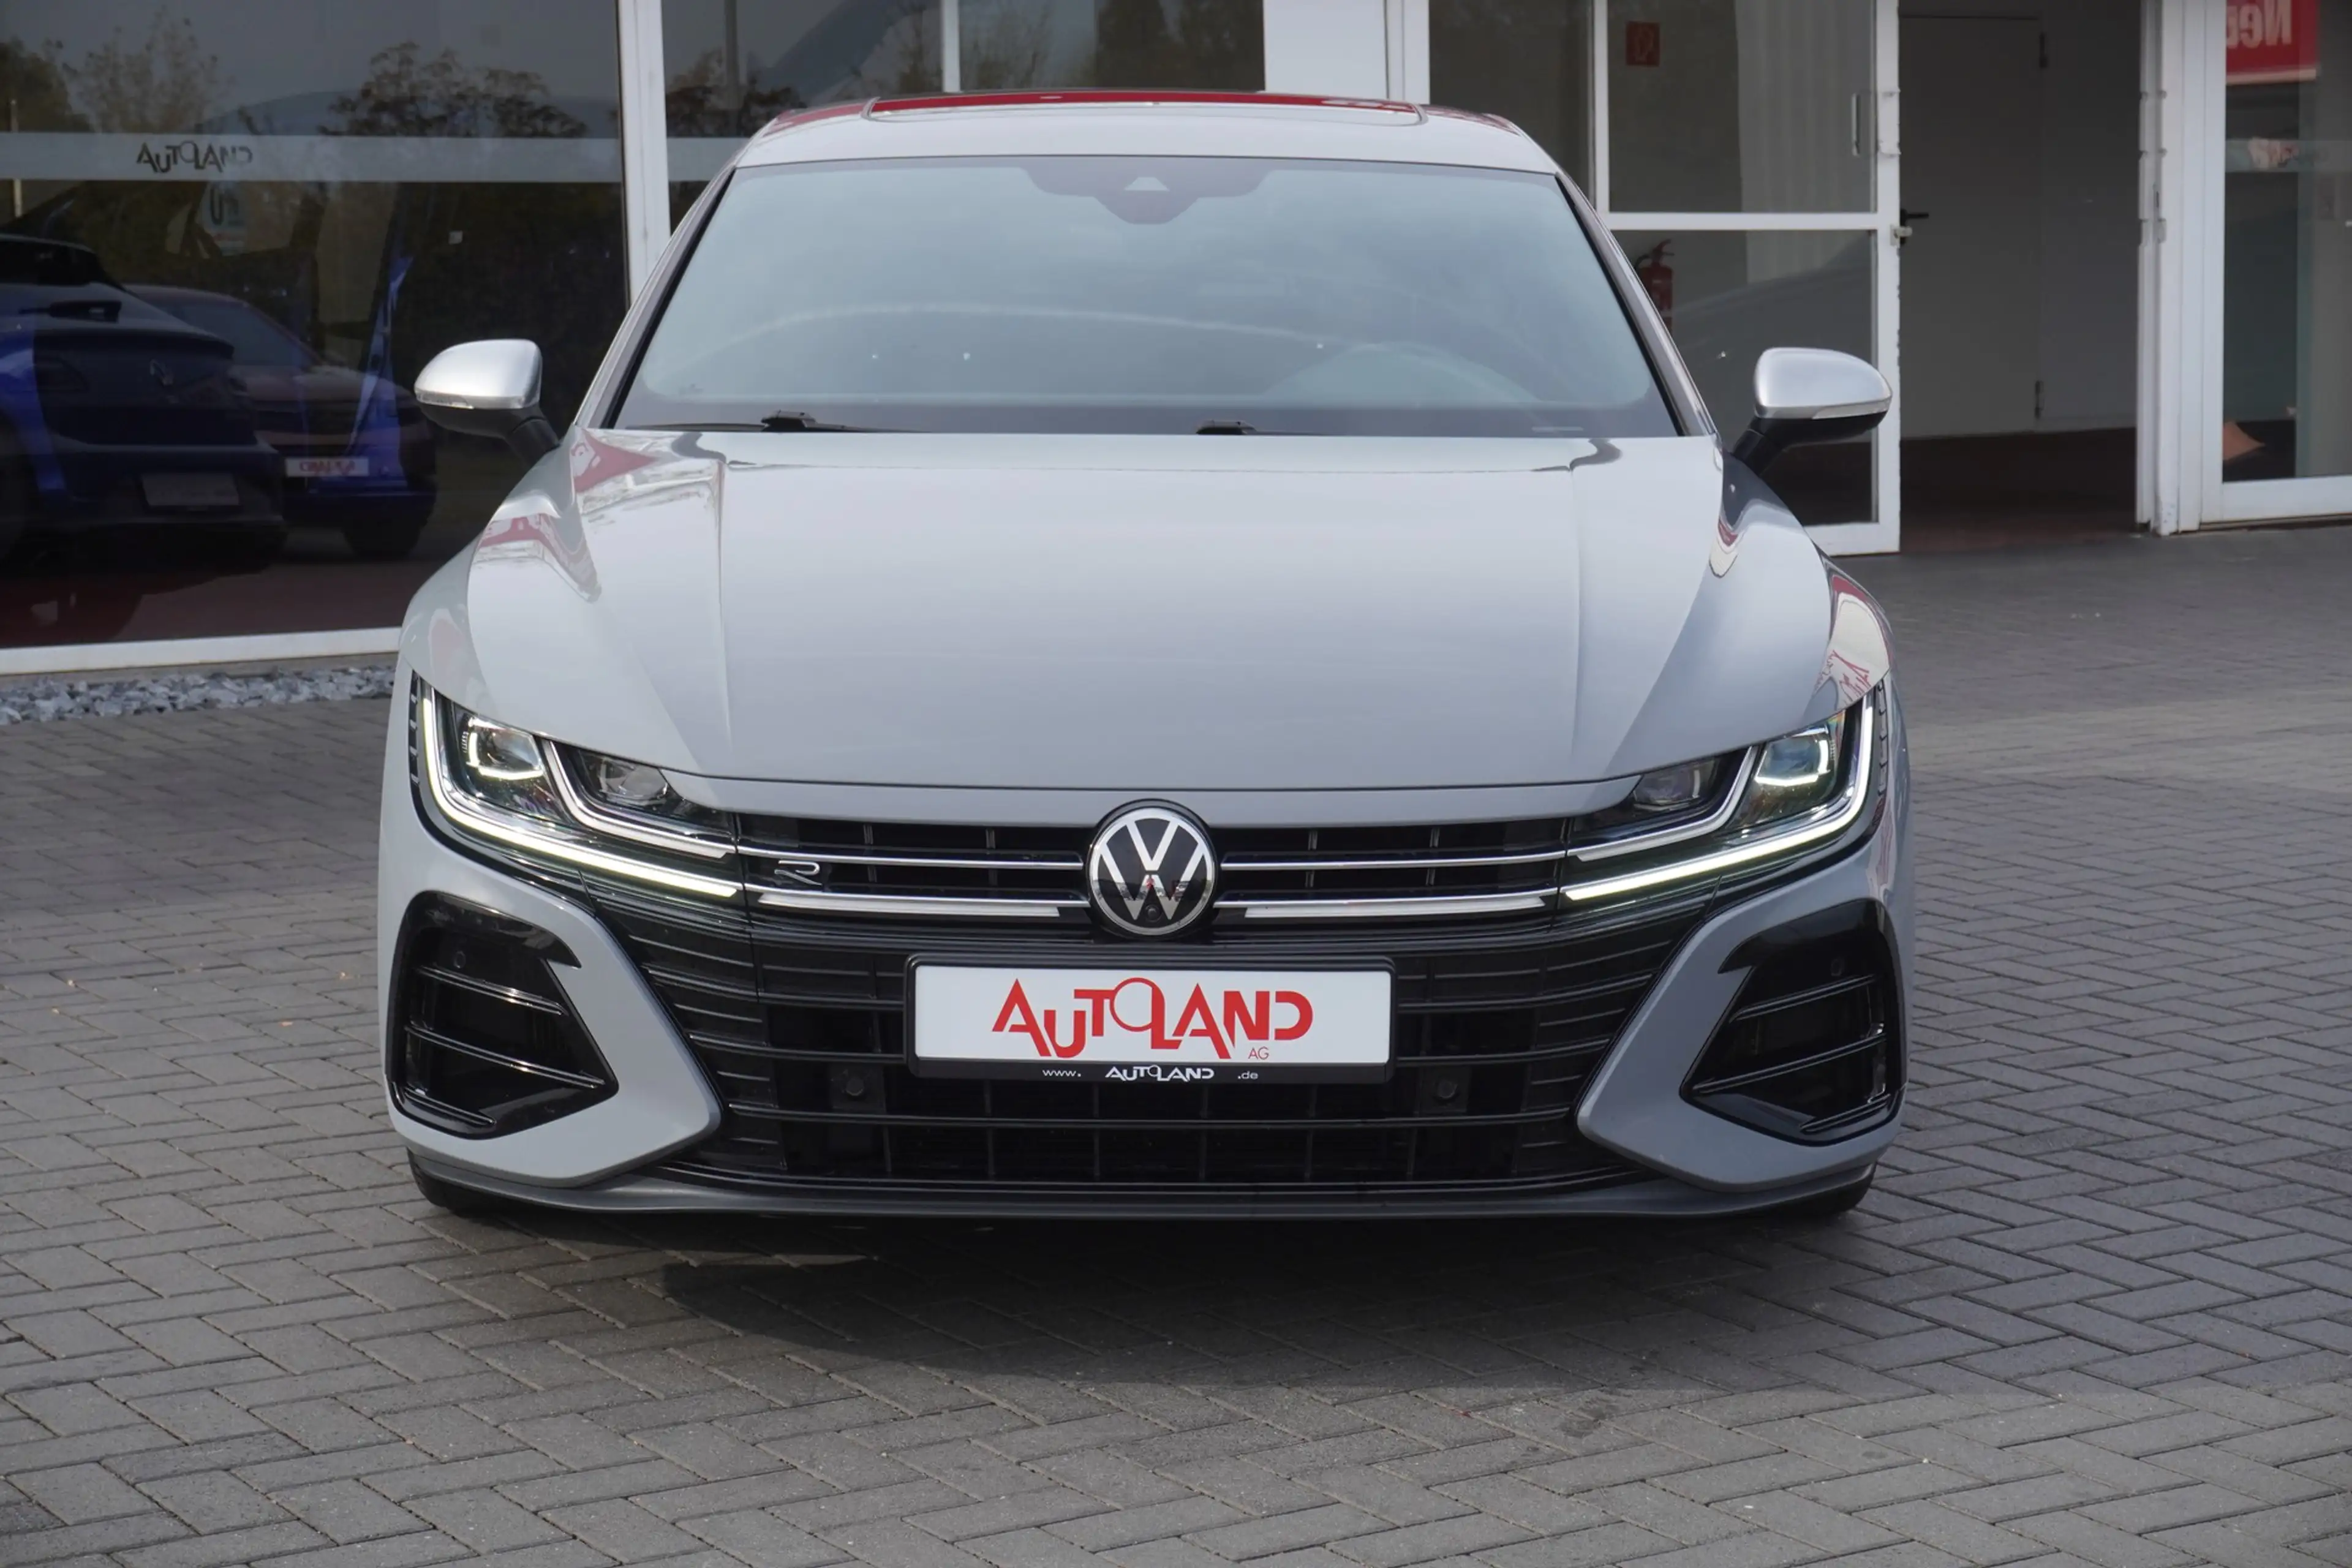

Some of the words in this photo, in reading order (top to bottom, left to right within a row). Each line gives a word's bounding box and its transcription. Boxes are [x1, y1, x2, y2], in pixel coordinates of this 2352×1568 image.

[1248, 1047, 1270, 1060] AG
[1042, 1069, 1082, 1077] www.
[1237, 1070, 1259, 1080] .de
